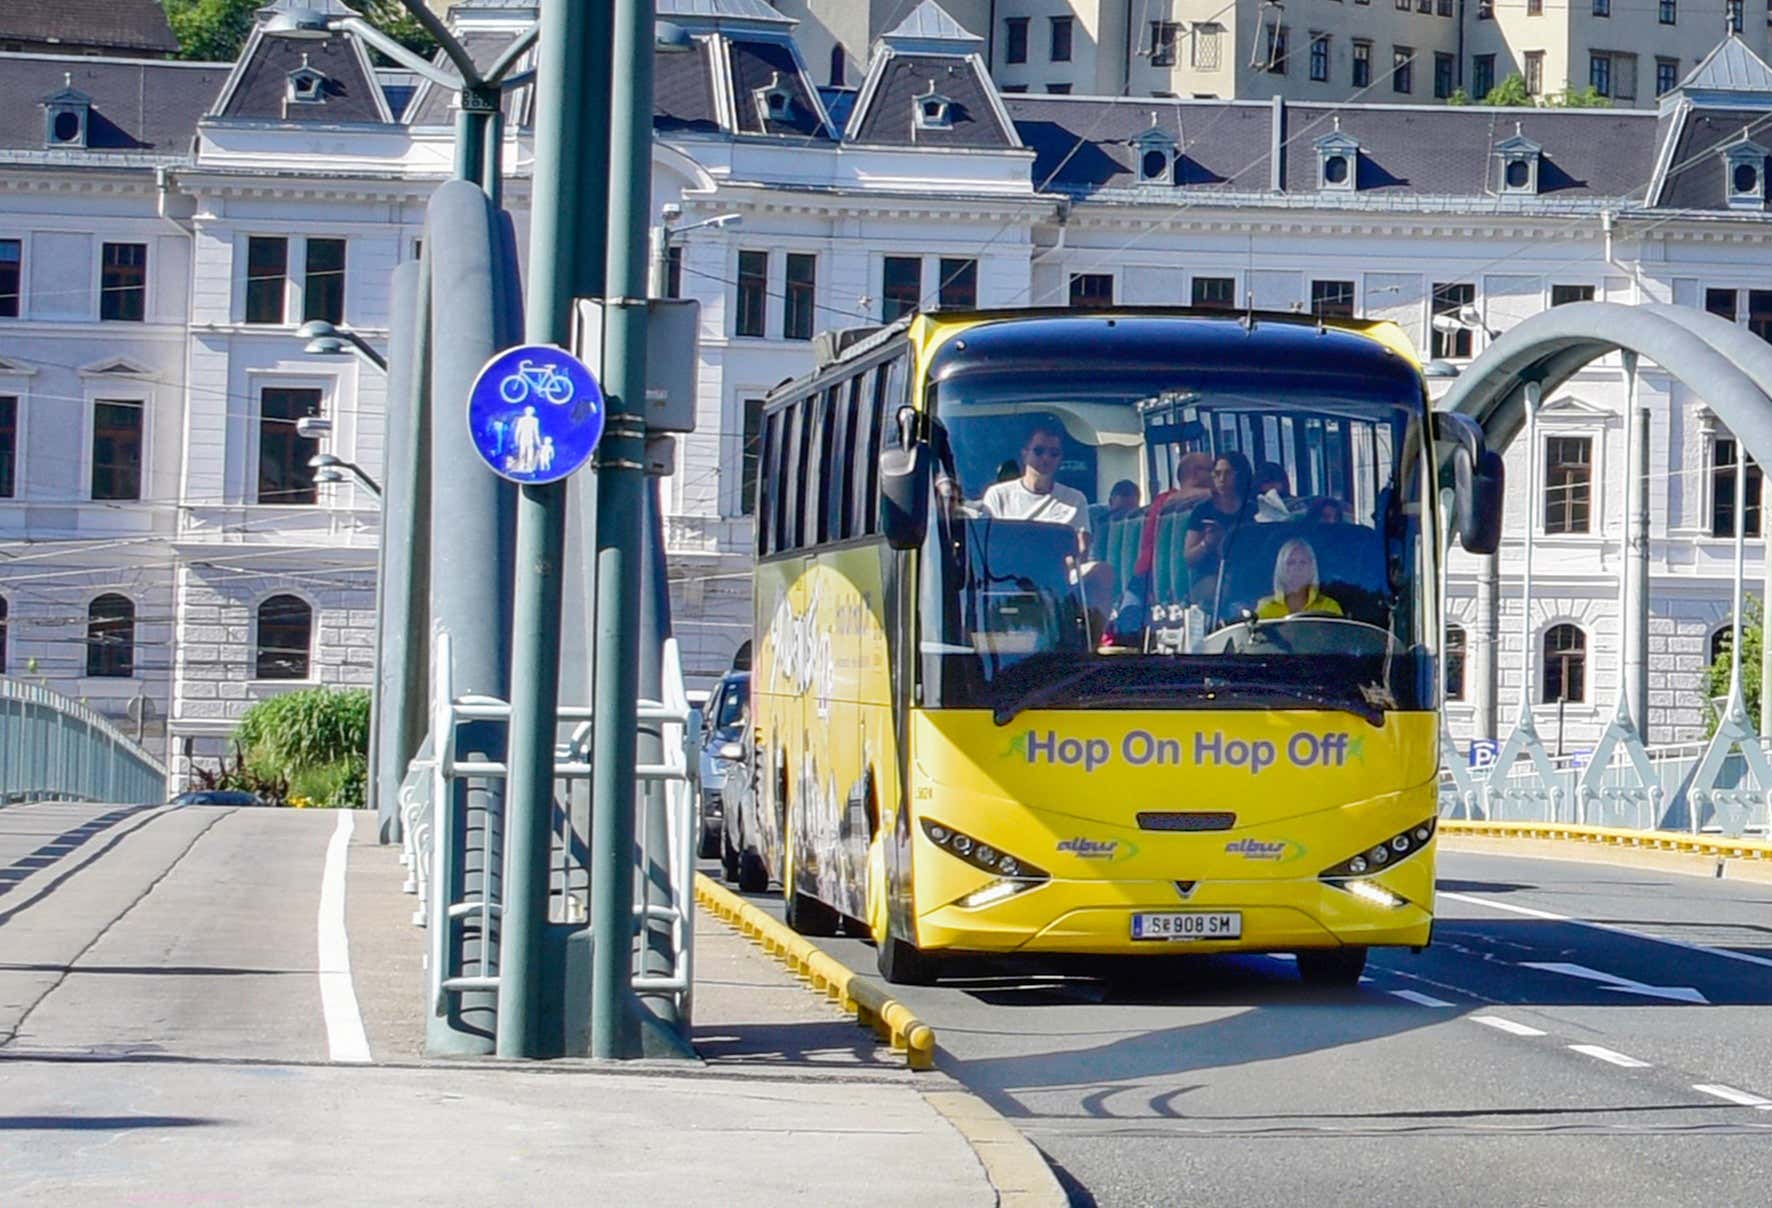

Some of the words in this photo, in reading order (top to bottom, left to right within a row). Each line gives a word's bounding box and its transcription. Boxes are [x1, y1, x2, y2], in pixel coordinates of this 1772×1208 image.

[1026, 729, 1110, 773] Hop
[1121, 729, 1181, 765] On
[1194, 731, 1276, 775] Hop
[1287, 731, 1349, 767] Off
[1055, 836, 1119, 853] albus
[1224, 837, 1287, 854] albus
[1173, 915, 1205, 933] 908
